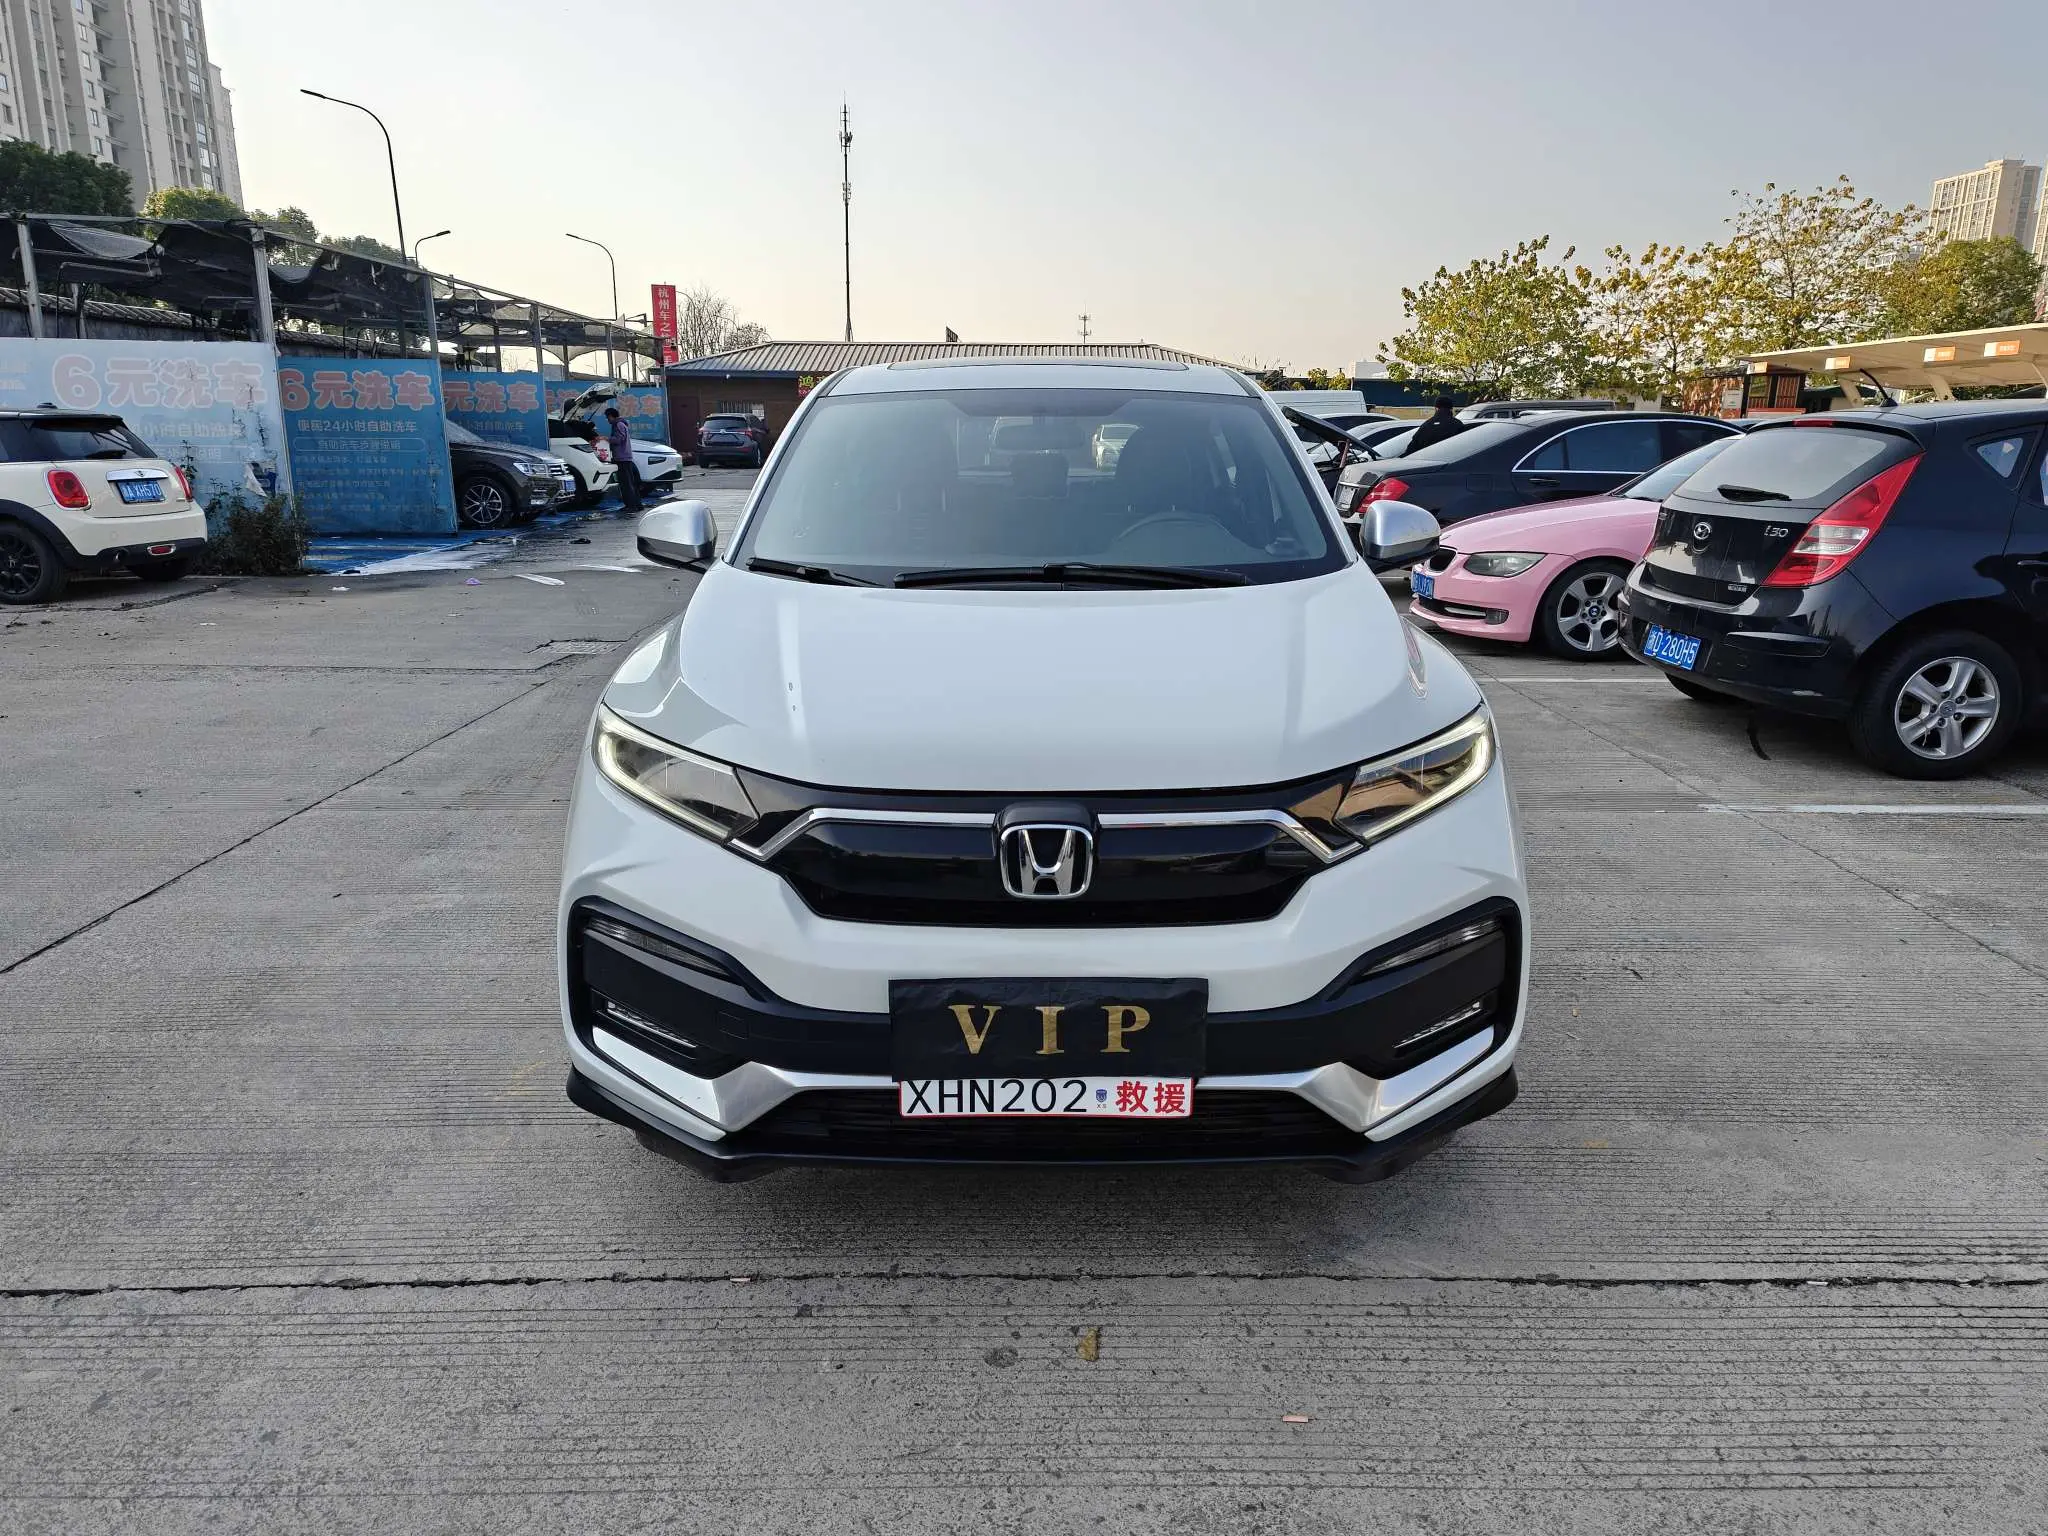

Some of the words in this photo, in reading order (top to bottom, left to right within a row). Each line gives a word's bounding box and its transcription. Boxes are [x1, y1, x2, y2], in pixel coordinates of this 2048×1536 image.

[52, 353, 268, 410] 6元洗车
[279, 368, 435, 411] 6元洗车
[948, 1003, 1151, 1055] VIP
[906, 1079, 1088, 1113] XHN202
[1115, 1080, 1186, 1114] 救援
